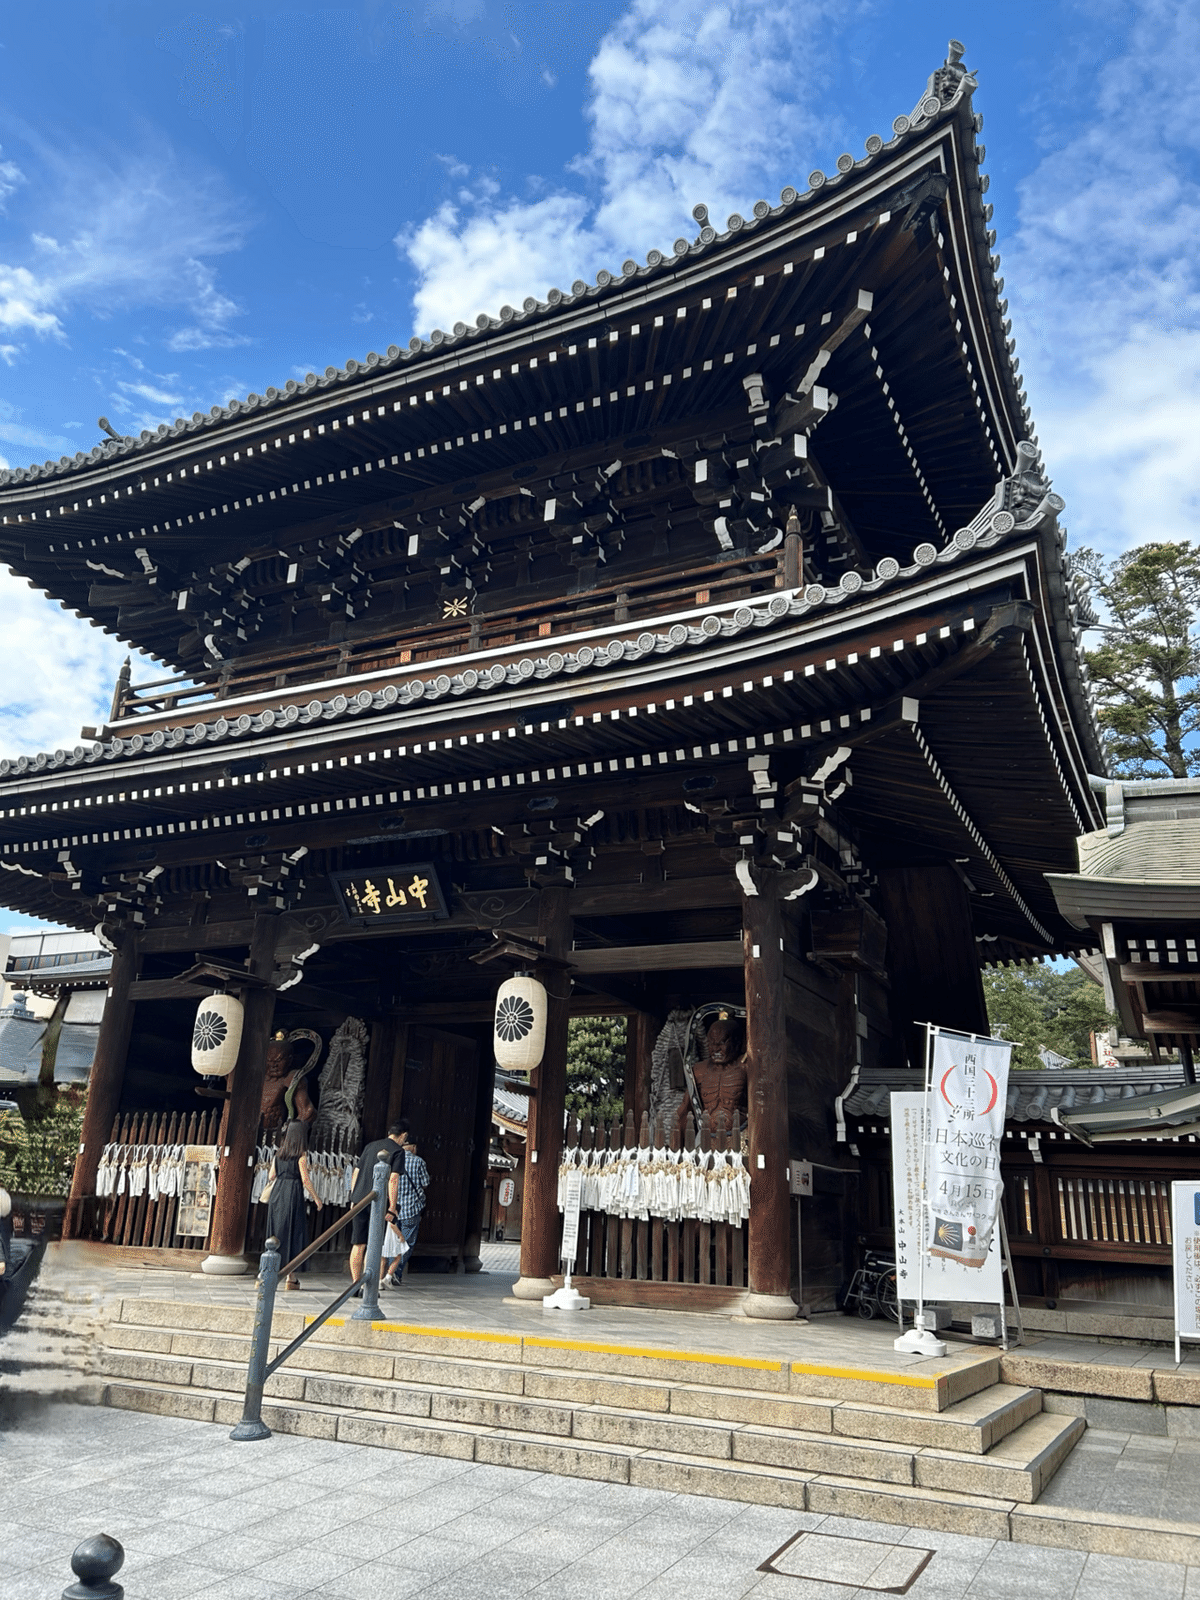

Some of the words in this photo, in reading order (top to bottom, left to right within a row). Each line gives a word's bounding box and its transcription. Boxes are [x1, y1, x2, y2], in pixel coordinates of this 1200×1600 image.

[963, 1054, 977, 1121] 西国三十三所
[940, 1150, 996, 1171] 文化の日
[938, 1180, 994, 1200] 4月15日
[898, 1240, 908, 1280] 中山寺
